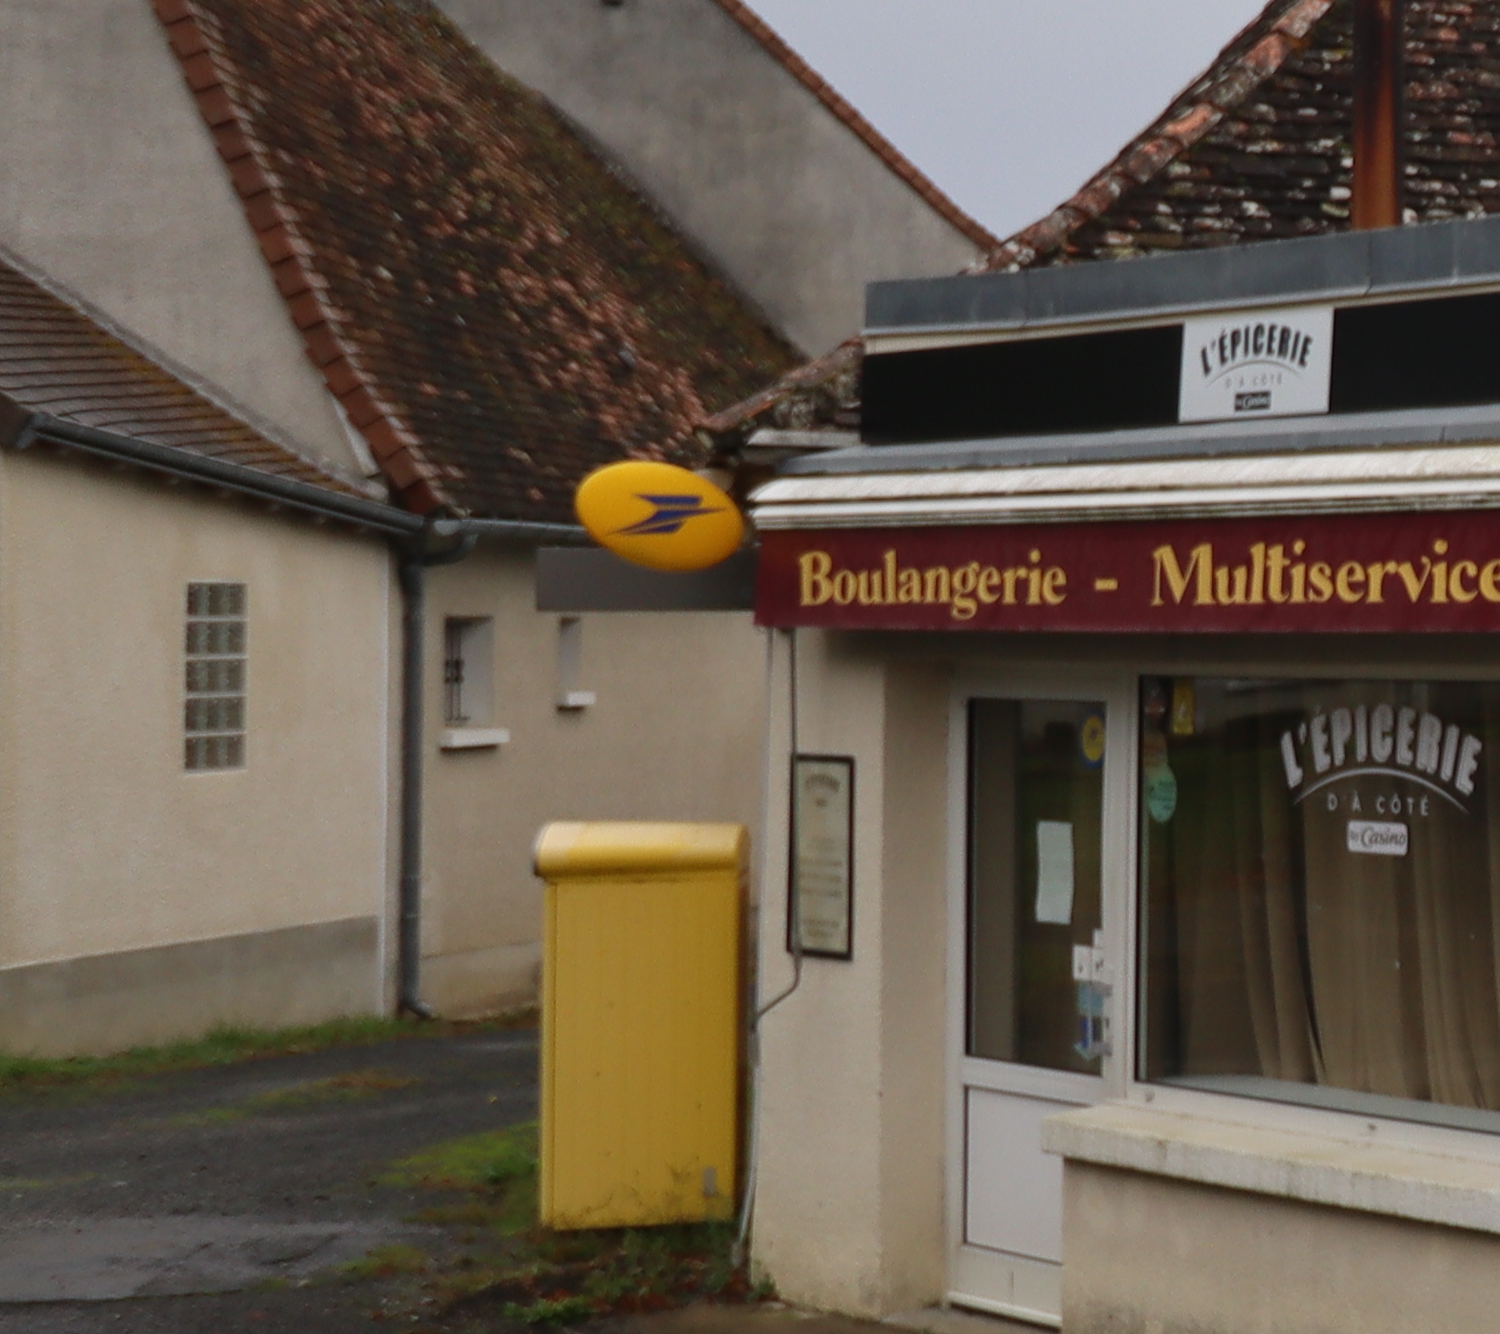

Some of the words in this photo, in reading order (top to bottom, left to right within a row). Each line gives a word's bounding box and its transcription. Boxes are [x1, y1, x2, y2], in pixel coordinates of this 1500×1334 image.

[1201, 323, 1313, 377] L'ÉPICERIE
[799, 549, 1067, 620] Boulangerie
[1280, 703, 1483, 796] L'ÉPICERIE
[1375, 793, 1429, 816] CÔTÉ
[1361, 826, 1406, 849] Casino
